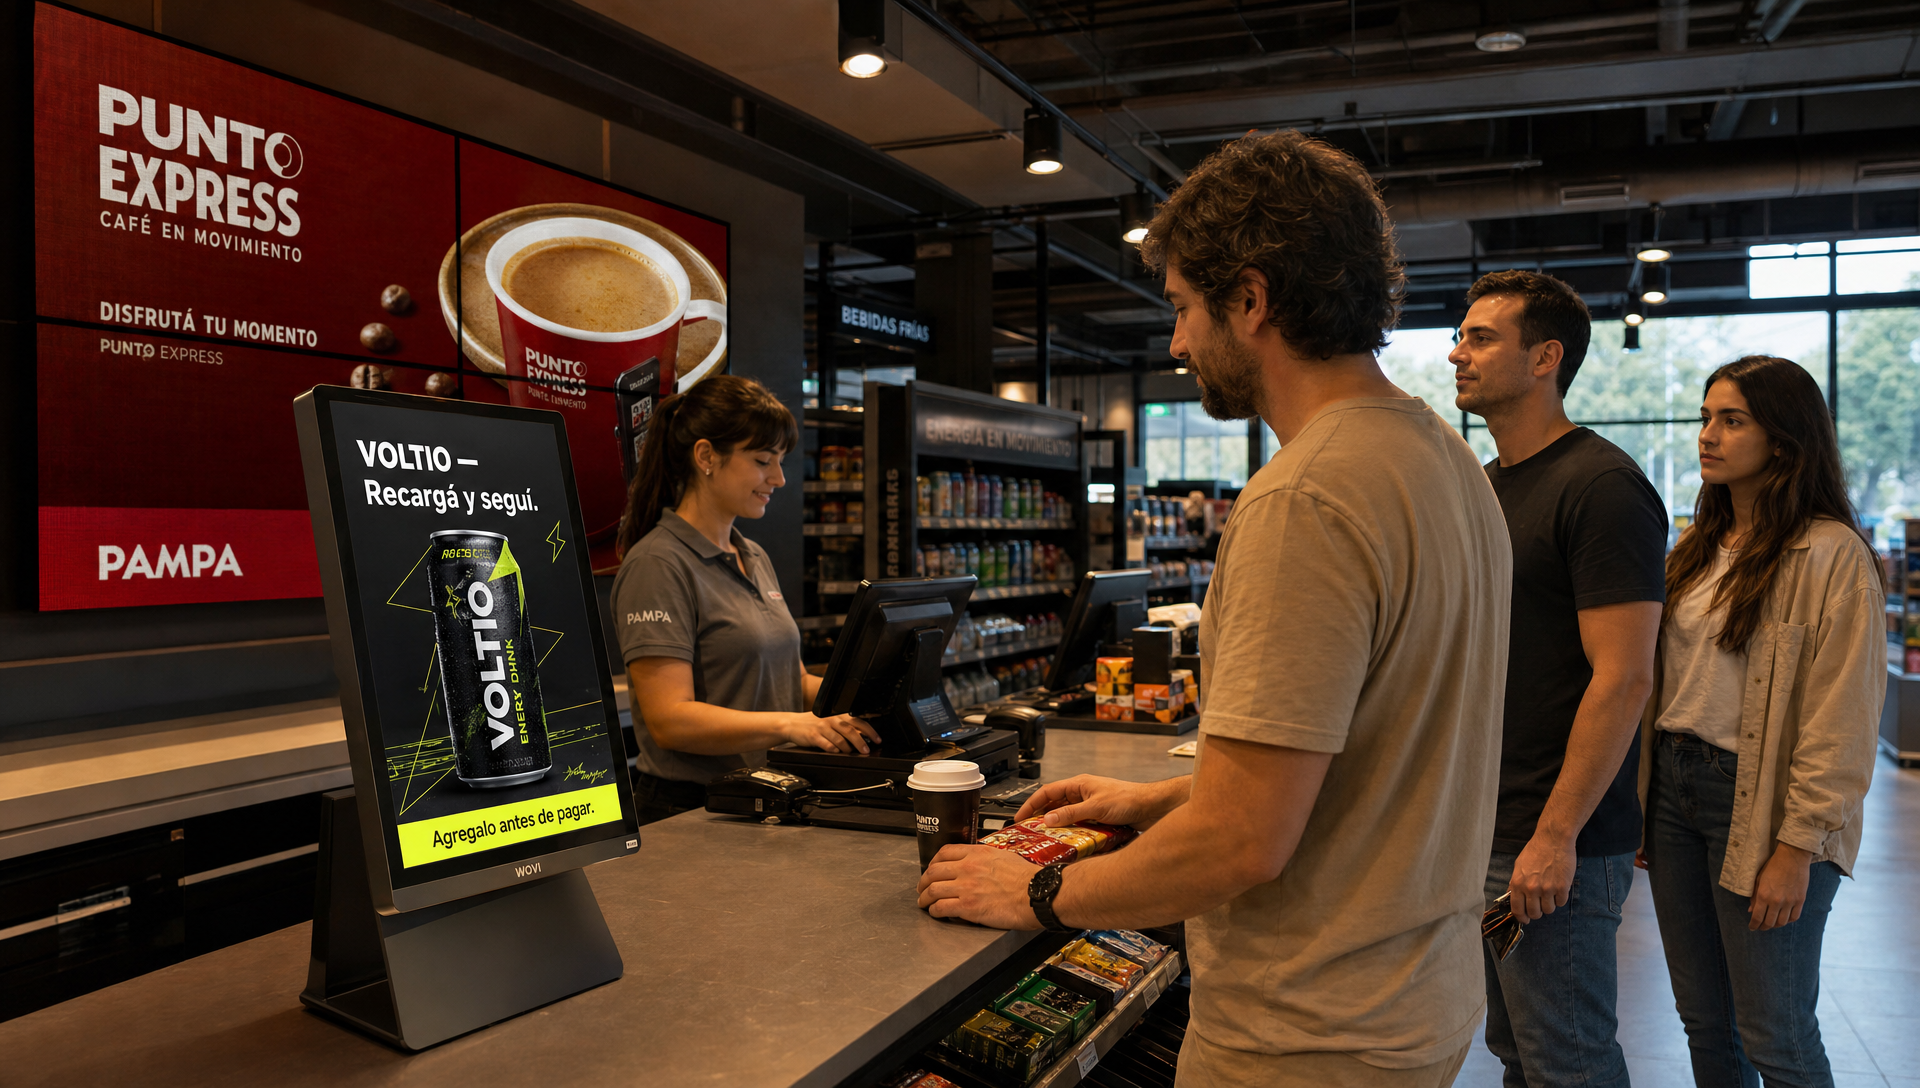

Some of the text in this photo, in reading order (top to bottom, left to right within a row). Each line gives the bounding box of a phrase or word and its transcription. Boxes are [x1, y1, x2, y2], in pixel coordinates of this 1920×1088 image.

[98, 83, 303, 179] PUNTO
[99, 144, 301, 237] EXPRESS
[100, 210, 302, 263] CAFÉ EN MOVIMIENTO
[100, 301, 318, 347] DISFRUTÁ TU MOMENTO
[841, 305, 929, 343] BEBIDAS FRÍAS
[100, 338, 223, 365] PUNTO EXPRESS
[525, 346, 587, 377] PUNTO
[356, 439, 452, 473] VOLTIO
[986, 428, 1004, 449] EN
[363, 479, 539, 517] Recargá y seguí.
[98, 543, 244, 581] PAMPA
[627, 610, 672, 625] PAMPA
[467, 581, 515, 751] VOLTIO
[432, 801, 595, 849] Agregalo antes de pagar.
[515, 862, 542, 878] WOVI
